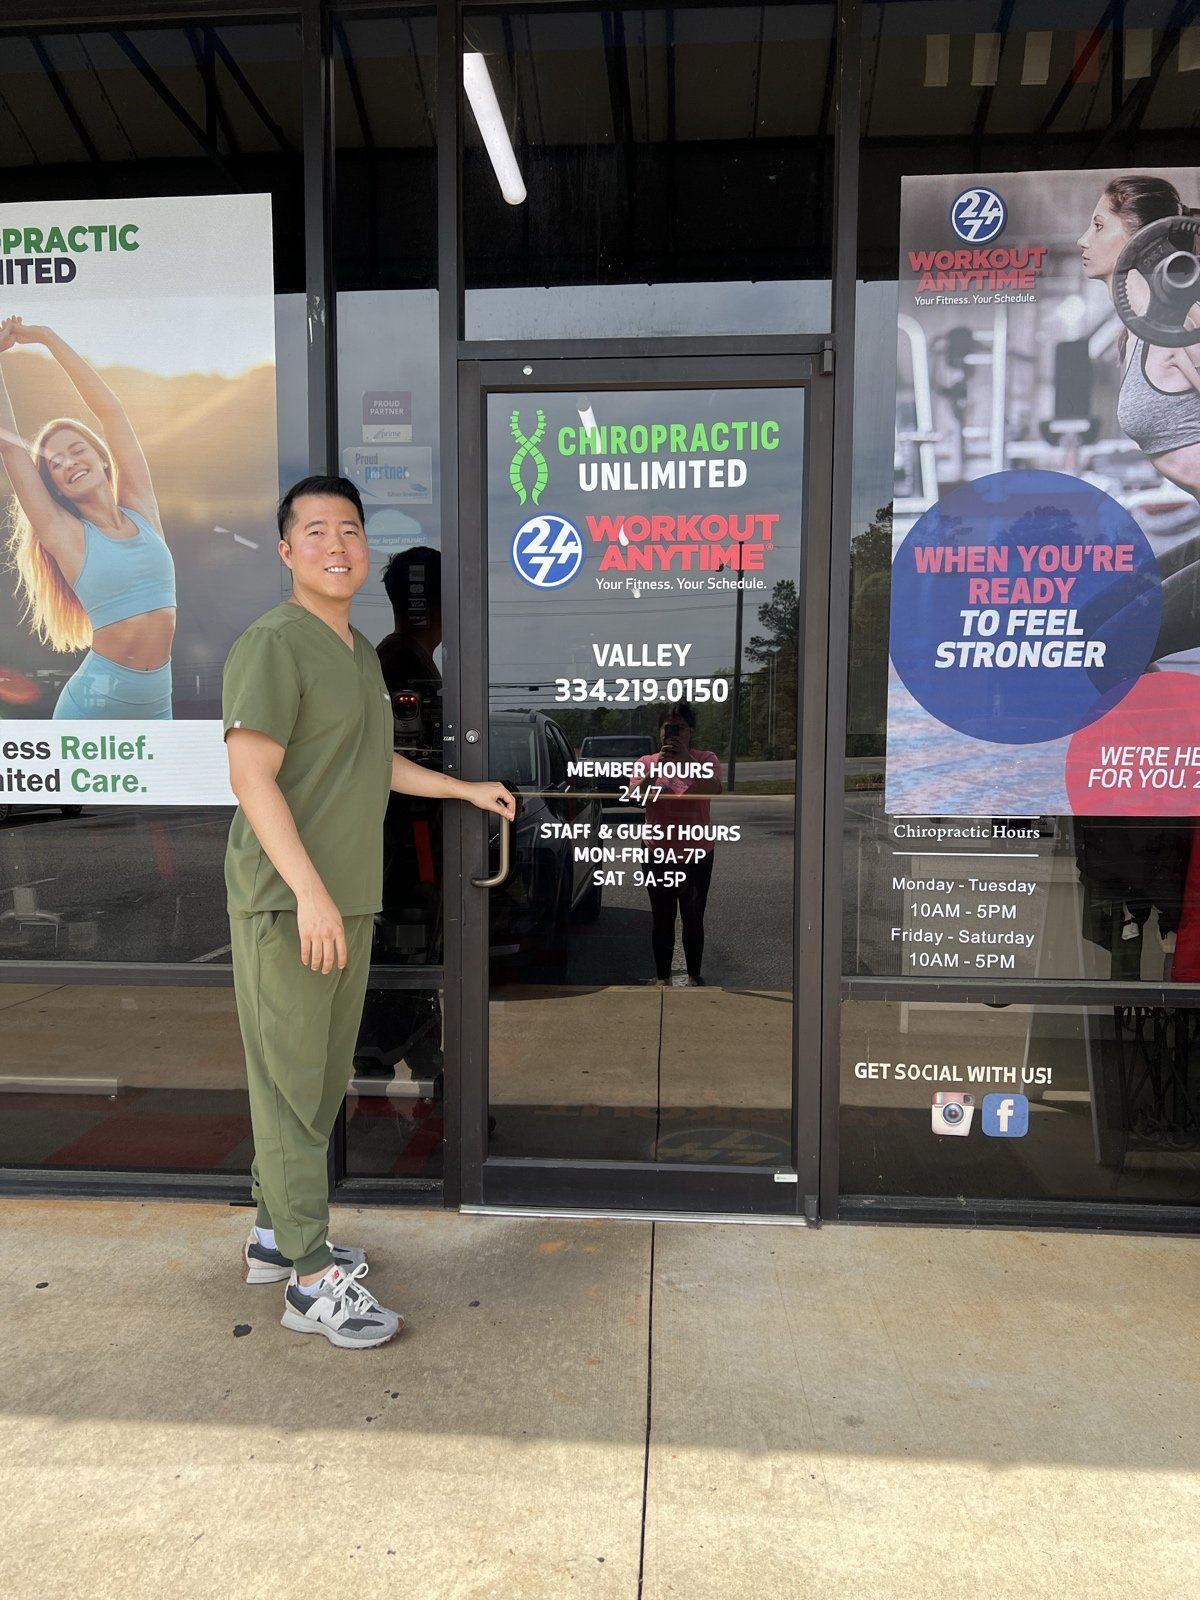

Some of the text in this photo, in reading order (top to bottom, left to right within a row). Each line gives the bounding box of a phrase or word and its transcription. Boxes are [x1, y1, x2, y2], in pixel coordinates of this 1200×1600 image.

[959, 192, 1003, 224] 24
[0, 224, 140, 254] PRACTIC
[0, 257, 77, 285] ITED
[908, 247, 1048, 272] WORKOUT
[916, 269, 1037, 292] ANYTIME
[915, 293, 1037, 305] Your Fitness. Your Schedule.
[558, 420, 780, 456] CHIROPRACTIC
[356, 453, 378, 464] Proud
[365, 464, 408, 483] partner
[579, 459, 748, 491] UNLIMITED
[585, 514, 780, 542] WORKOUT
[522, 520, 582, 564] 24
[914, 544, 1134, 573] WHEN YOU'RE
[596, 577, 767, 590] Your Fitness. Your Schedule.
[968, 577, 1076, 605] READY
[960, 609, 1084, 637] TO FEEL
[593, 644, 692, 667] VALLEY
[934, 640, 1107, 668] STRONGER
[554, 678, 729, 703] 334.219.0150
[2, 735, 154, 760] ess Relief.
[1101, 746, 1170, 766] WE'RE
[70, 768, 147, 793] Care.
[567, 761, 714, 779] MEMBER HOURS
[1088, 768, 1133, 788] FOR
[1139, 768, 1187, 789] YOU.
[619, 785, 662, 807] 24/7
[541, 823, 591, 839] STAFF
[599, 824, 612, 839] &
[678, 825, 741, 841] HOURS
[893, 825, 1040, 842] Chiropractic Hours
[574, 847, 706, 864] MON-FRI 9A-7P
[593, 871, 687, 888] SAT 9A-5P
[892, 877, 955, 894] Monday
[968, 879, 1036, 895] Tuesday
[910, 903, 960, 918] 10AM
[977, 904, 1017, 919] 5PM
[891, 928, 944, 946] Friday
[958, 930, 1035, 948] Saturday
[909, 952, 959, 967] 10AM
[975, 954, 1015, 969] 5PM
[854, 1062, 1053, 1085] GET SOCIAL WITH US!
